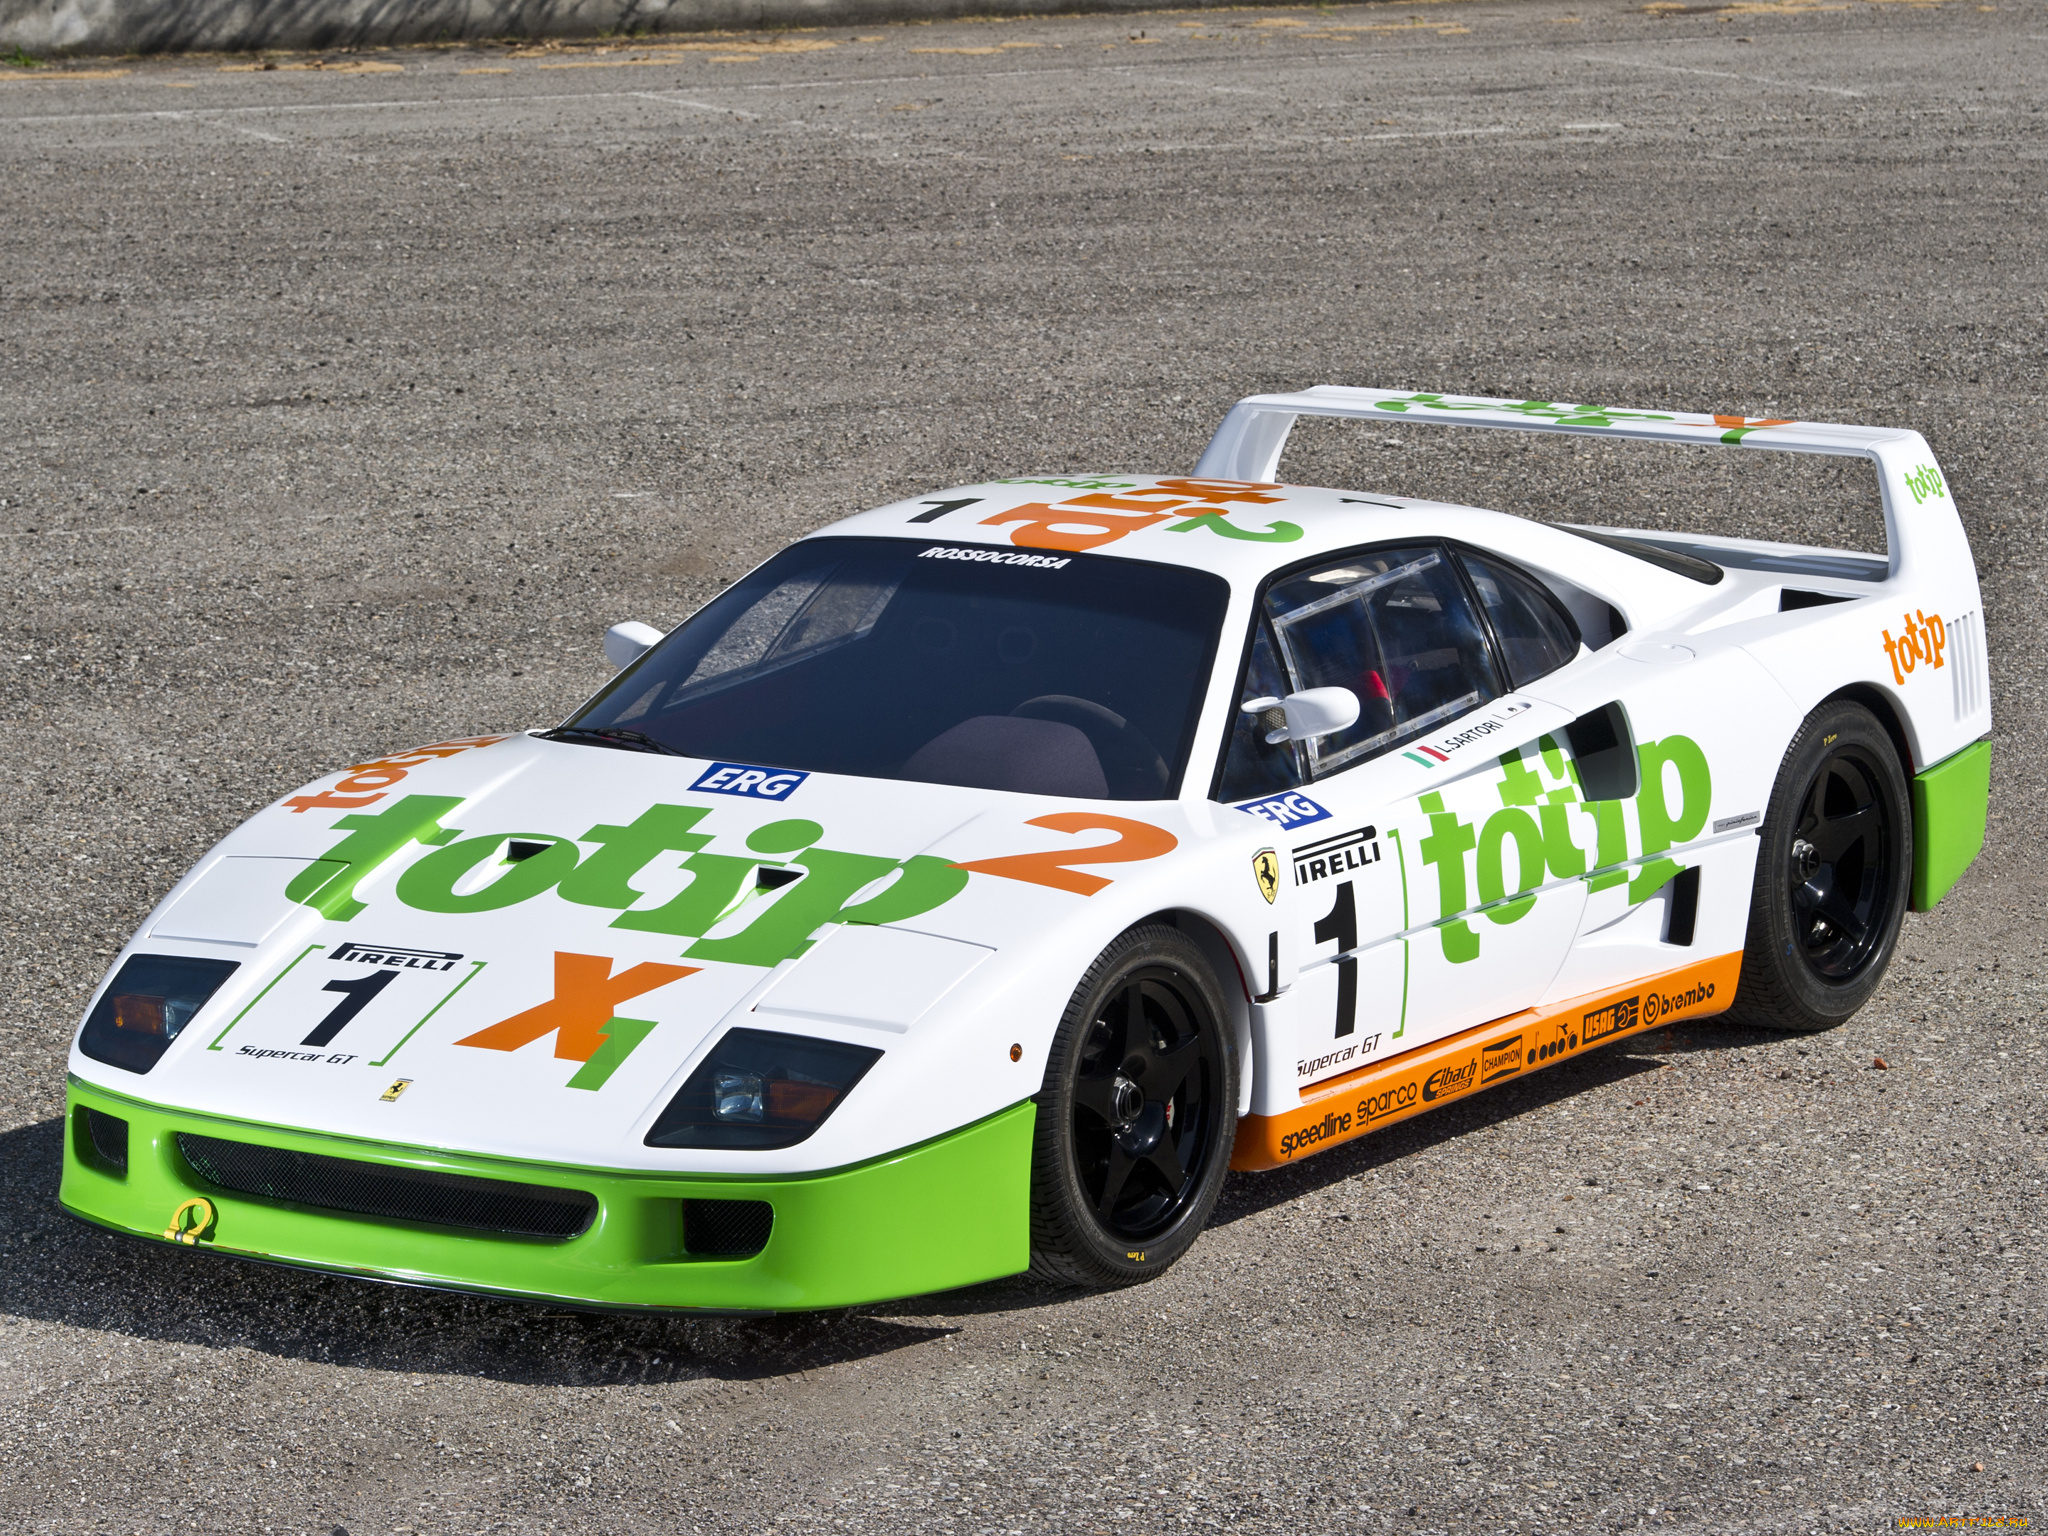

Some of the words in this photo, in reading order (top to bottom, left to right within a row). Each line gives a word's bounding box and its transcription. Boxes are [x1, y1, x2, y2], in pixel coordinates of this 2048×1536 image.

[1904, 463, 1945, 505] totip
[905, 497, 987, 524] 1
[917, 546, 1072, 570] ROSSOCORSA
[1881, 608, 1946, 686] totip
[696, 767, 801, 796] ERG
[943, 812, 1178, 897] 2
[1415, 733, 1712, 964] totip
[284, 795, 969, 968] totip
[327, 942, 464, 971] PIRELLI
[1314, 880, 1357, 1039] 1
[300, 969, 401, 1047] 1
[451, 951, 706, 1063] X
[1661, 981, 1715, 1016] brembo
[1361, 1032, 1382, 1055] GT
[1586, 1010, 1615, 1040] USAG
[235, 1045, 325, 1063] Supercar
[326, 1054, 359, 1065] GT
[564, 1016, 660, 1092] 1
[1484, 1047, 1521, 1073] CHAMPION
[1422, 1058, 1478, 1102] Eibach
[1434, 1079, 1471, 1099] SPRINGS
[1356, 1082, 1417, 1126] sparco
[1280, 1112, 1351, 1158] speedline
